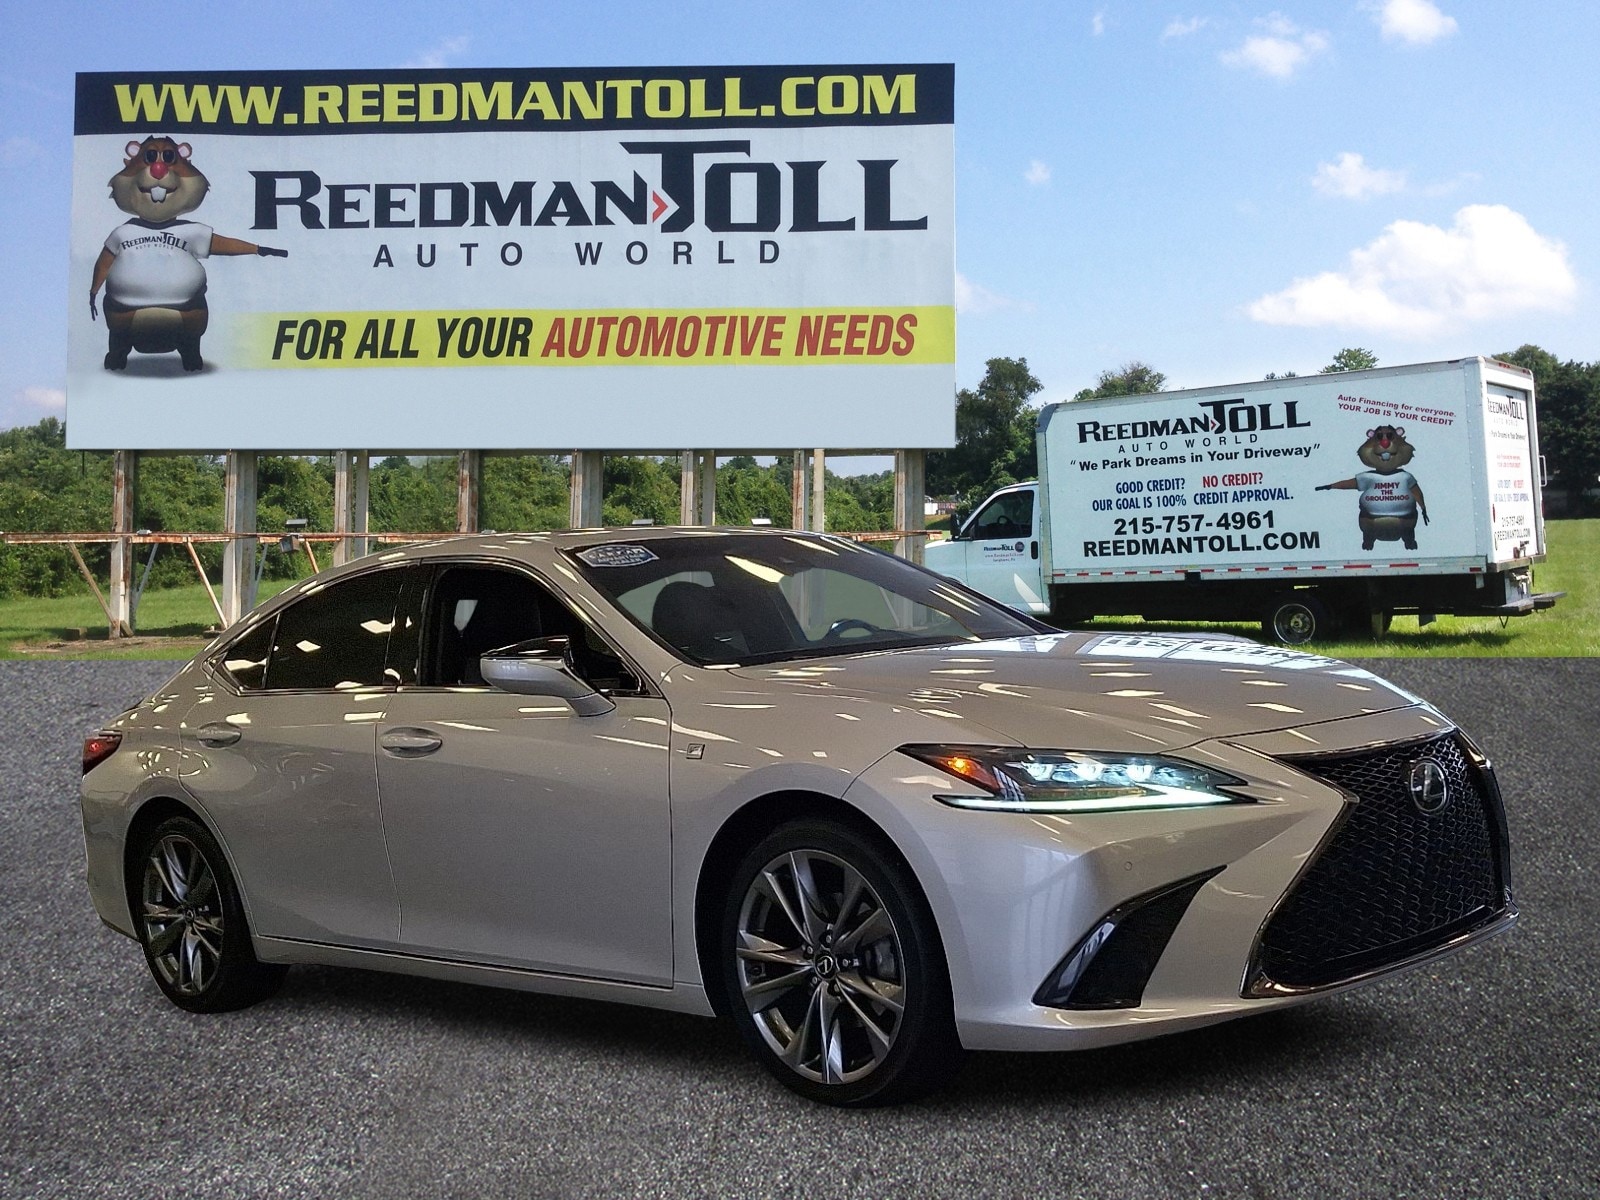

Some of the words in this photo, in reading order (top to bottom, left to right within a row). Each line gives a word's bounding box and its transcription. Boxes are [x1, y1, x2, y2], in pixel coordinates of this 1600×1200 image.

[114, 73, 917, 125] WWW.REEDMANTOLL.COM
[373, 242, 523, 269] AUTO
[575, 240, 781, 266] WORLD
[272, 319, 347, 361] FOR
[354, 318, 419, 360] ALL
[436, 317, 534, 359] YOUR
[540, 314, 786, 359] AUTOMOTIVE
[795, 313, 918, 357] NEEDS
[1337, 394, 1357, 403] Auto
[1358, 397, 1399, 410] Financing
[1401, 403, 1413, 411] for
[1415, 406, 1457, 418] everyone.
[1338, 403, 1361, 412] YOUR
[1363, 407, 1381, 415] JOB
[1383, 409, 1392, 417] IS
[1394, 411, 1418, 421] YOUR
[1420, 415, 1454, 426] CREDIT
[1118, 441, 1168, 454] AUTO
[1185, 433, 1258, 449] WORLD
[1102, 457, 1132, 470] Park
[1135, 453, 1186, 467] Dreams
[1190, 452, 1203, 463] in
[1207, 450, 1240, 462] Your
[1116, 480, 1143, 494] GOOD
[1146, 477, 1186, 493] CREDIT?
[1202, 475, 1219, 488] NO
[1221, 472, 1263, 487] CREDIT?
[1374, 481, 1400, 490] JIMMY
[1092, 499, 1113, 512] OUR
[1116, 497, 1141, 511] GOAL
[1143, 496, 1152, 509] IS
[1156, 494, 1187, 509] 100%
[1193, 491, 1228, 506] CREDIT
[1232, 487, 1294, 504] APPROVAL.
[1365, 494, 1410, 502] GROUNDHOG
[1084, 531, 1320, 557] REEDMANTOLL.COM
